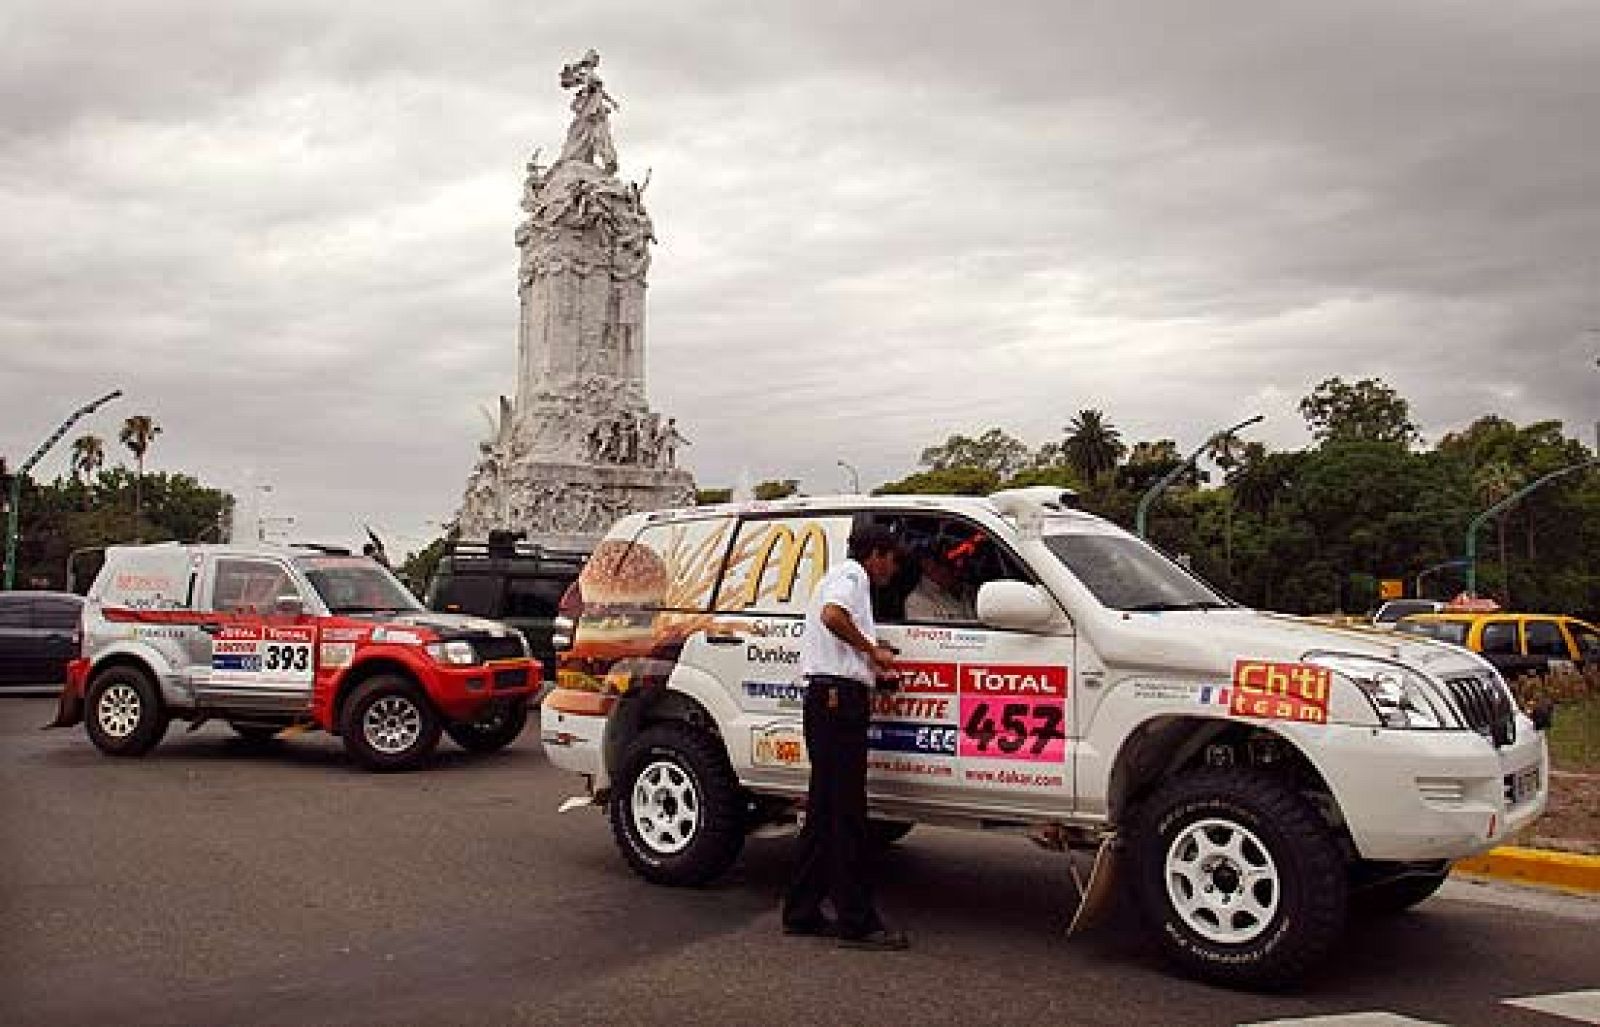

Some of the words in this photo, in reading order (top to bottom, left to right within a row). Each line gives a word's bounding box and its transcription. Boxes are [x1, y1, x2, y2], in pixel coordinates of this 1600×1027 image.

[219, 627, 257, 638] TOTAL
[267, 627, 309, 641] TOTAL
[265, 645, 309, 671] 393
[747, 645, 800, 663] Dunker
[968, 668, 1057, 693] TOTAL
[1239, 664, 1327, 701] Ch'ti
[1235, 694, 1322, 721] team
[964, 702, 1064, 755] 457
[965, 769, 1063, 787] www.dakar.com
